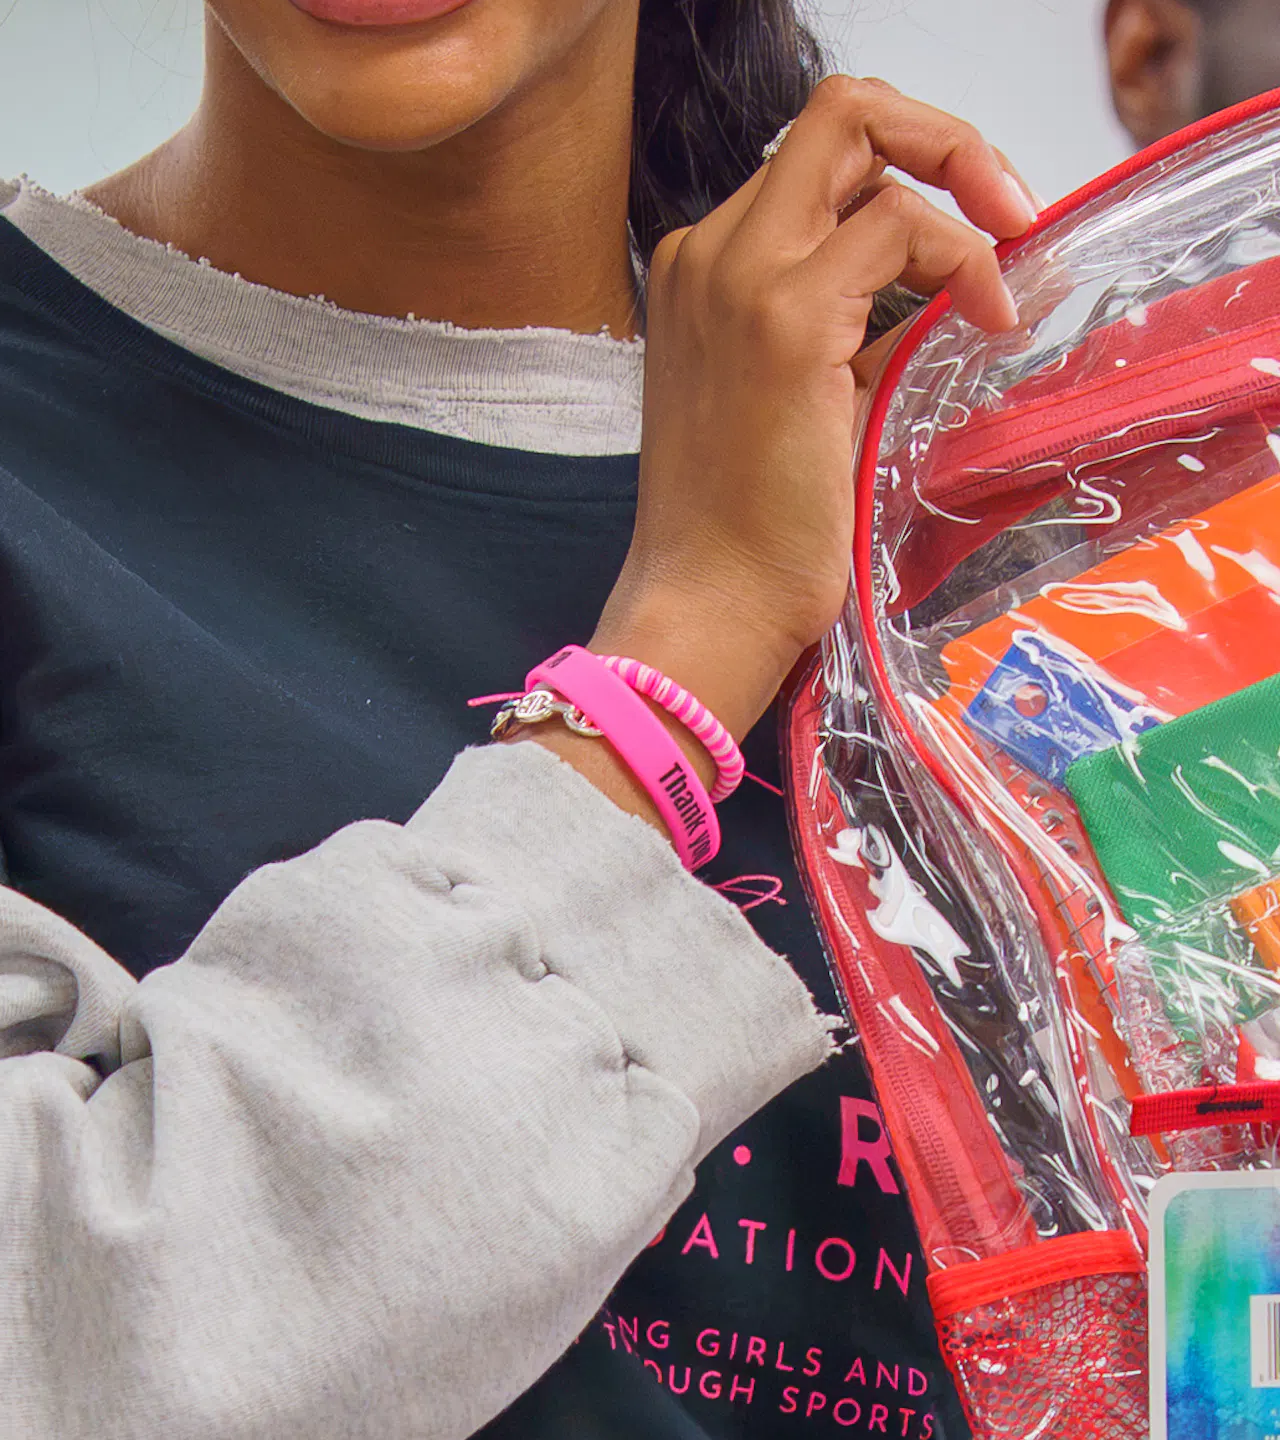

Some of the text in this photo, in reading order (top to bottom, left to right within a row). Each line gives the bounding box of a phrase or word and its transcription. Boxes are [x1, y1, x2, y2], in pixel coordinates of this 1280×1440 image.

[659, 762, 707, 837] Thank
[648, 1212, 912, 1297] ATION
[696, 1328, 823, 1377] GIRLS
[844, 1357, 928, 1397] AND
[779, 1386, 936, 1440] SPORTS
